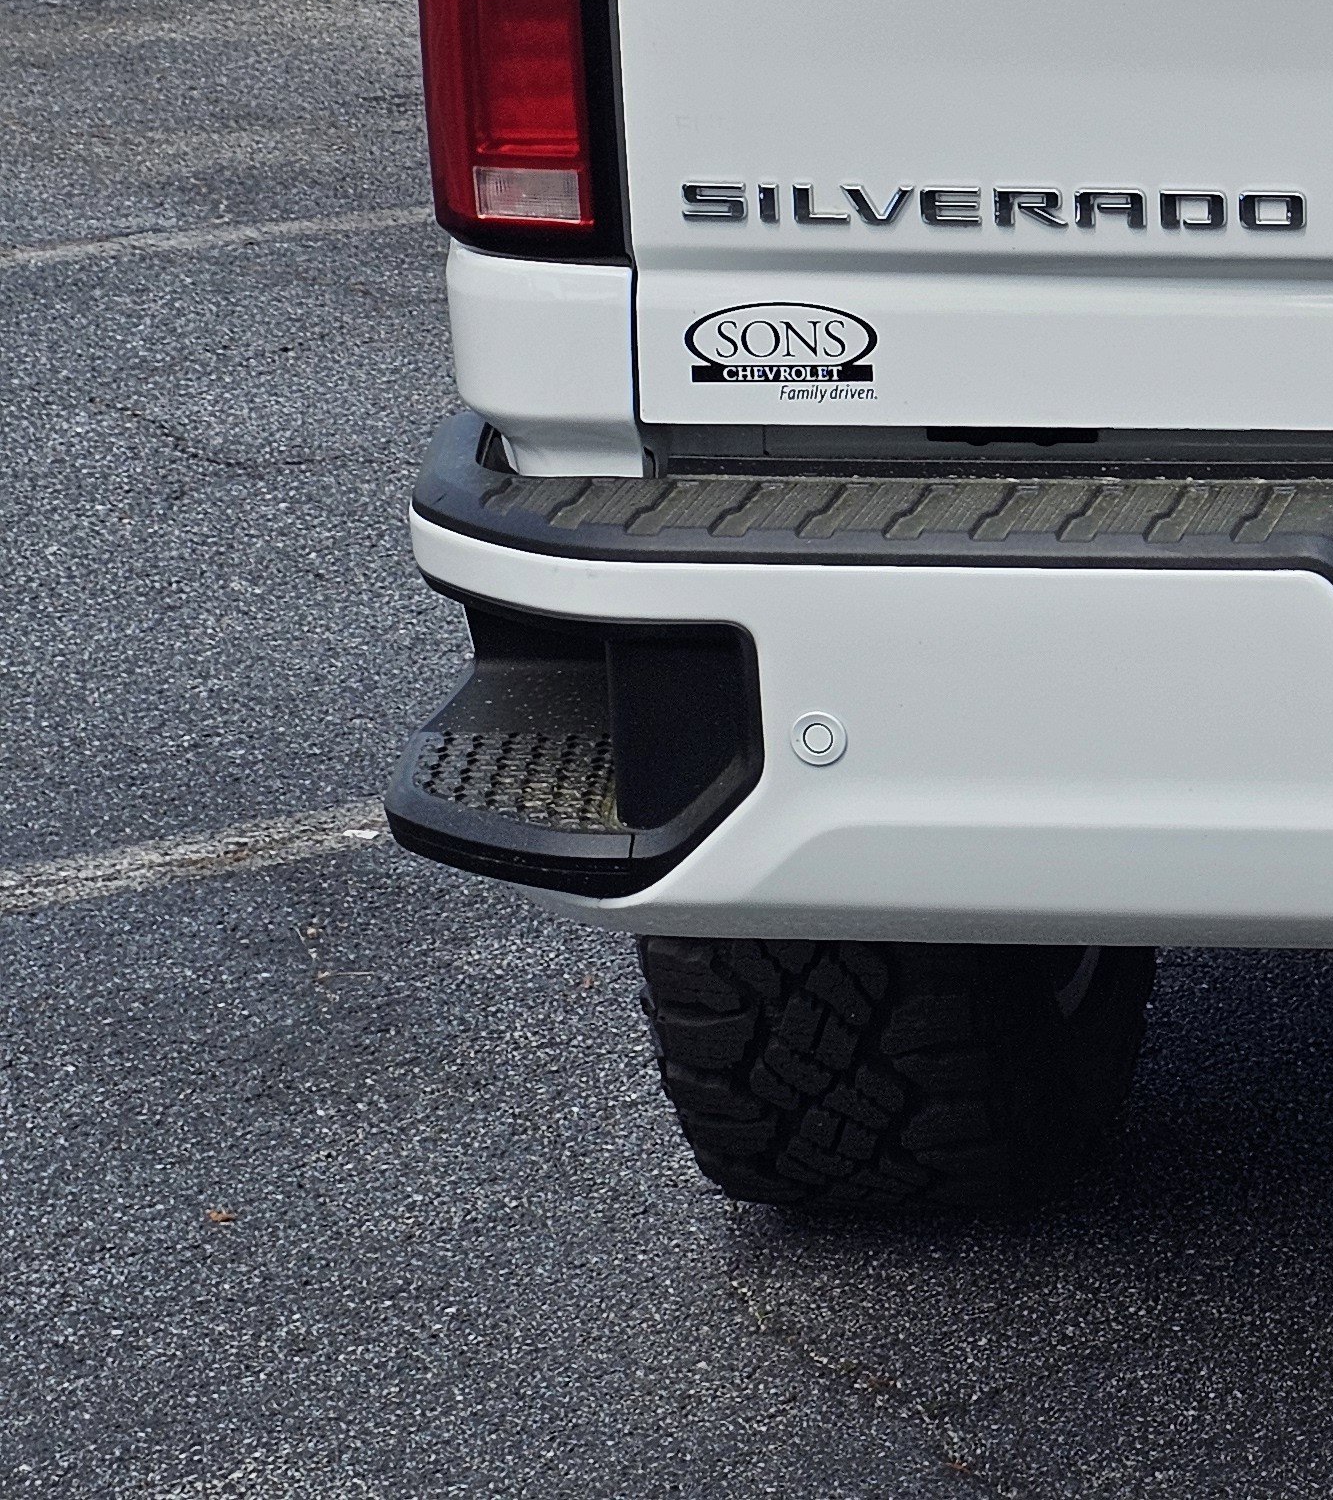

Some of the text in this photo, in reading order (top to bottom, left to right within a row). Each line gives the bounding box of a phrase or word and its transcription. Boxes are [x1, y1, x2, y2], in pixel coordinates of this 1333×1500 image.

[682, 181, 1307, 230] SILVERADO
[716, 319, 847, 358] SONS
[722, 365, 843, 381] CHEVROLET
[779, 383, 878, 403] Family driven.
